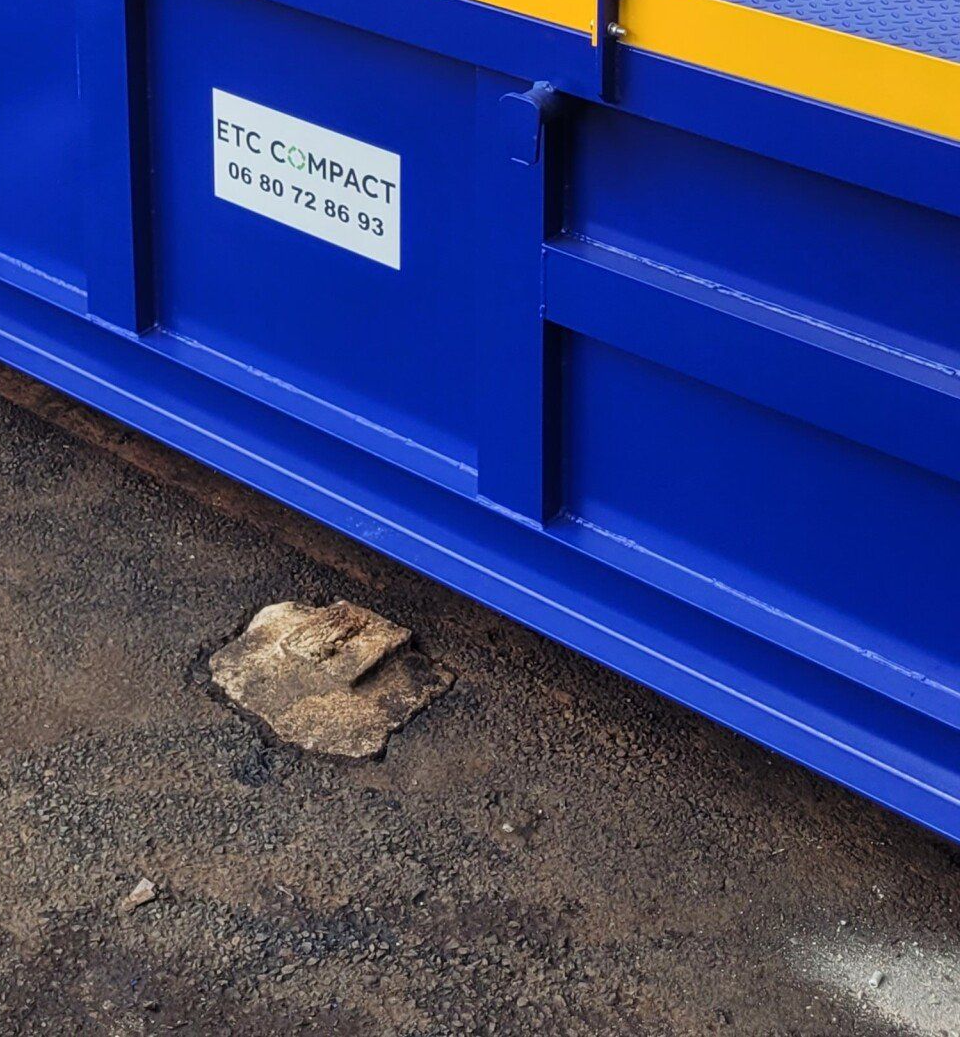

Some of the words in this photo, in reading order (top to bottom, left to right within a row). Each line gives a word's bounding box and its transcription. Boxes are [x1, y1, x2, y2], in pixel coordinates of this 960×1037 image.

[217, 119, 261, 154] ETC
[270, 140, 396, 204] COMPACT
[228, 162, 252, 185] 06
[259, 174, 284, 197] 80
[291, 185, 317, 211] 72
[324, 199, 350, 223] 86
[357, 212, 384, 237] 93
